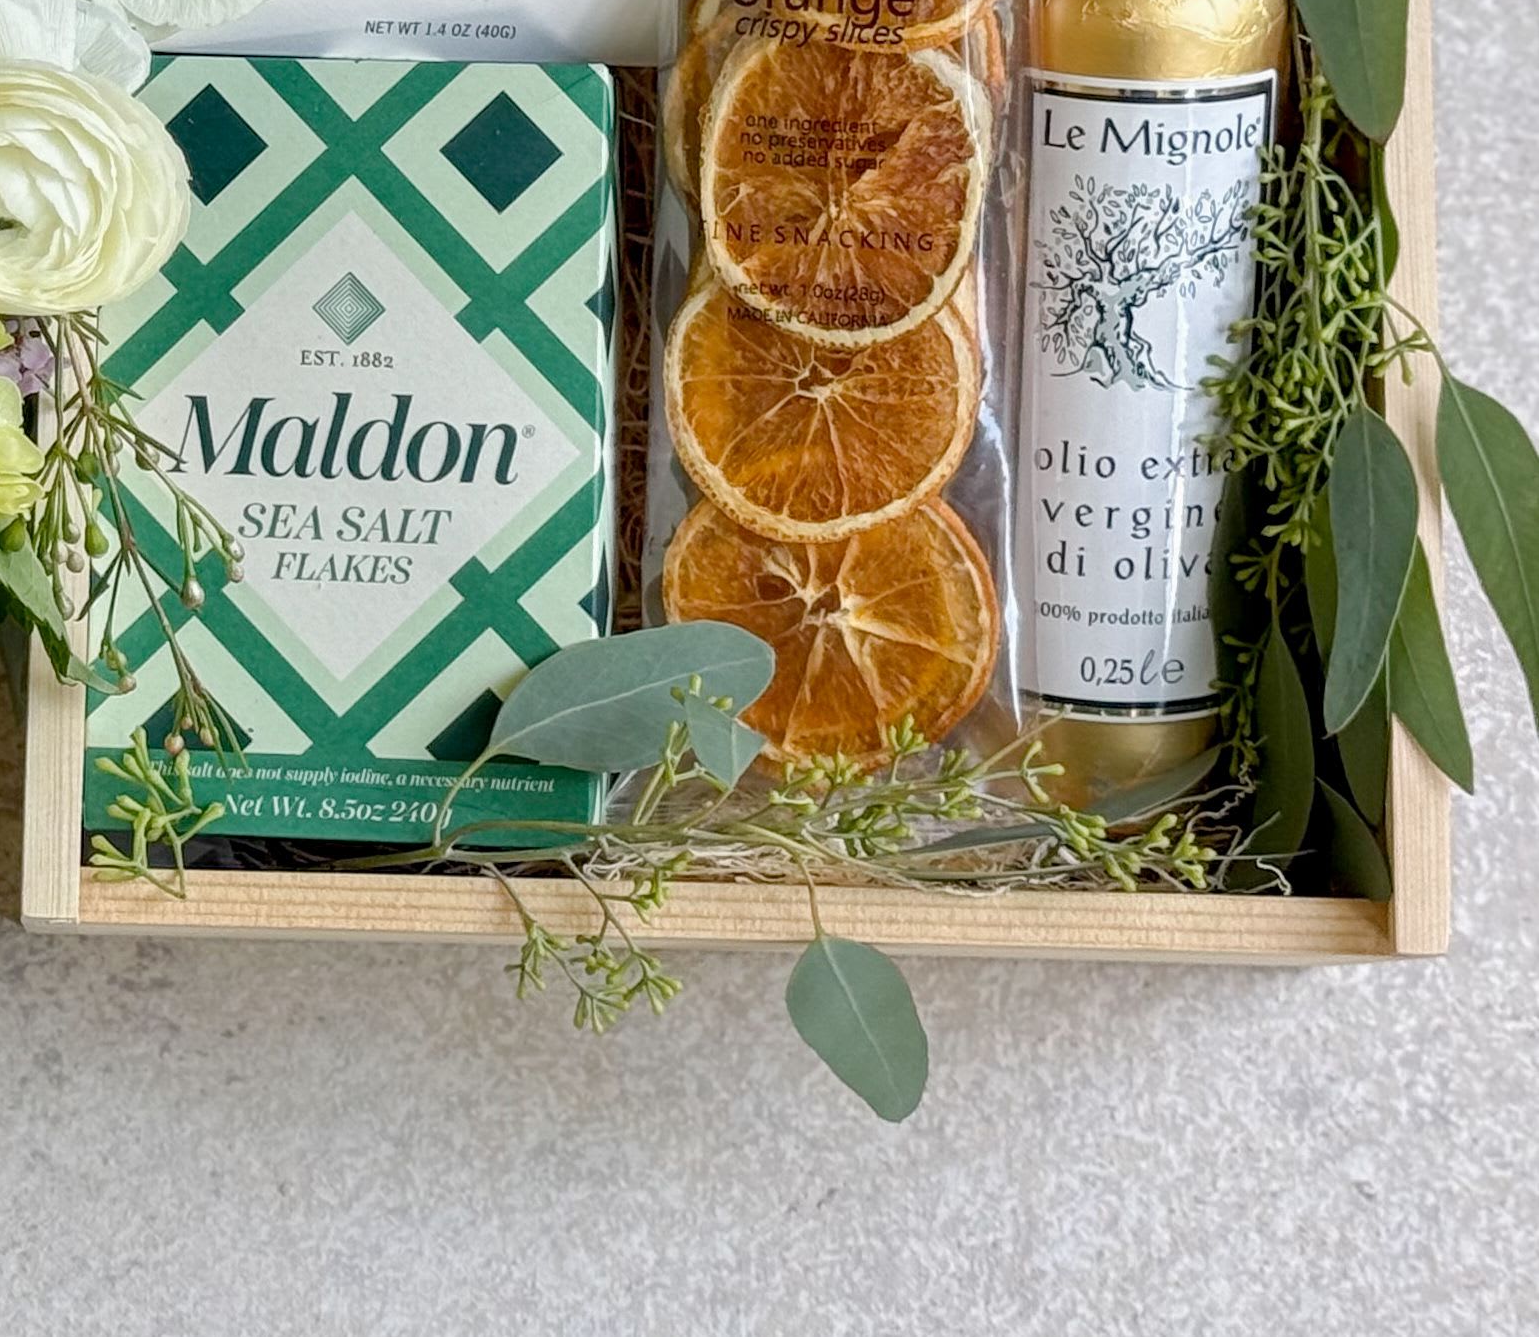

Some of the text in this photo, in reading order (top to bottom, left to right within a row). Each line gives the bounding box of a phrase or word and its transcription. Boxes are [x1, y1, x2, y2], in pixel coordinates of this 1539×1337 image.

[364, 19, 517, 41] NET WT 1.4 OZ (40G)
[735, 10, 906, 48] crispy slices
[745, 114, 879, 135] one ingredient
[1042, 108, 1086, 151] Le
[740, 130, 888, 153] no preservatives
[743, 149, 766, 165] no
[771, 150, 829, 169] added
[773, 224, 935, 251] SNACKING
[300, 349, 395, 369] EST. 1882
[1035, 439, 1116, 479] olio
[238, 503, 453, 546] SEA SALT
[271, 551, 414, 586] FLAKES
[1046, 539, 1087, 578] di
[1036, 601, 1082, 622] 00%
[1087, 607, 1164, 627] prodotto
[255, 766, 283, 781] not
[284, 766, 338, 787] supply
[396, 773, 407, 786] a
[490, 776, 555, 793] nutrient
[224, 793, 264, 817] Net
[271, 794, 312, 819] Wt.
[318, 798, 385, 822] 8.5oz
